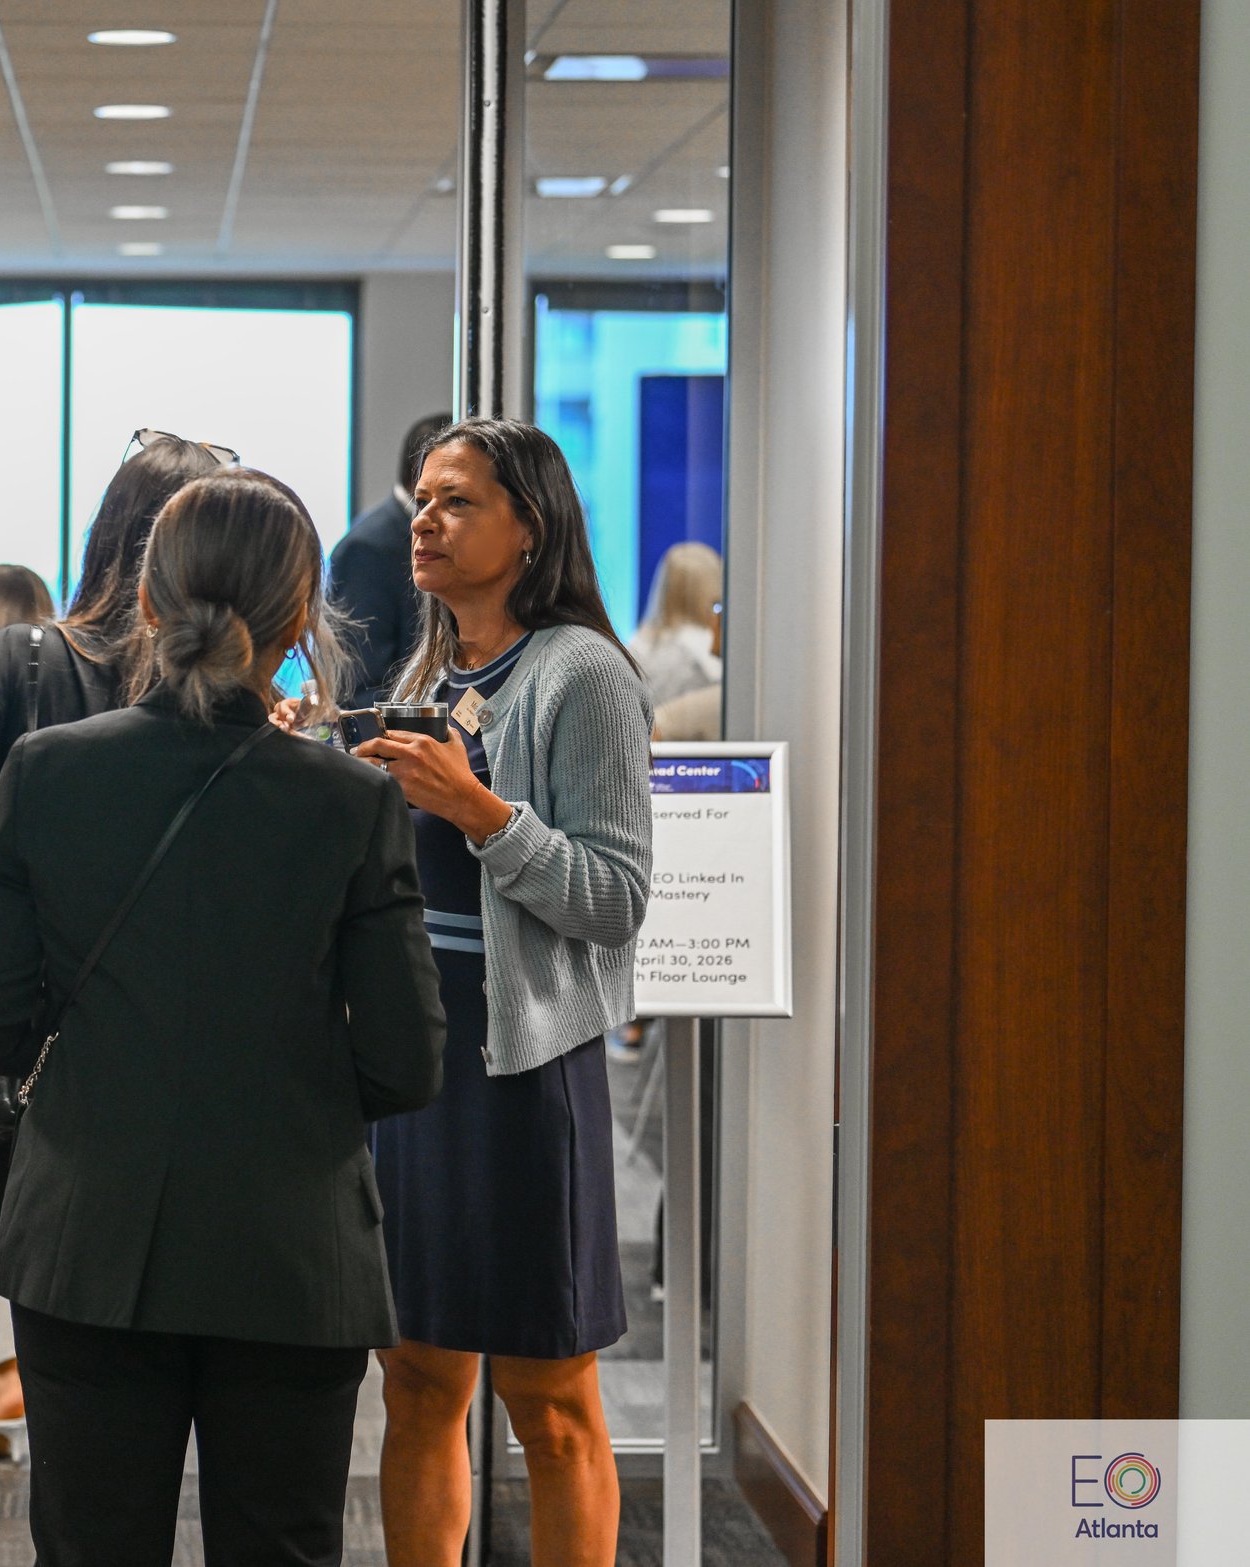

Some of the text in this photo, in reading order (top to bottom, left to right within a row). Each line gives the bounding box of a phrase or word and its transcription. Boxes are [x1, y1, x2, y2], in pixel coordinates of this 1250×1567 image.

[676, 764, 721, 776] Center
[654, 808, 729, 819] served For
[653, 873, 744, 884] EO Linked In
[650, 890, 710, 902] Mastery
[725, 938, 750, 949] PM
[670, 955, 691, 967] 30,
[697, 955, 733, 966] 2026
[650, 971, 687, 982] Floor
[692, 972, 747, 985] Lounge
